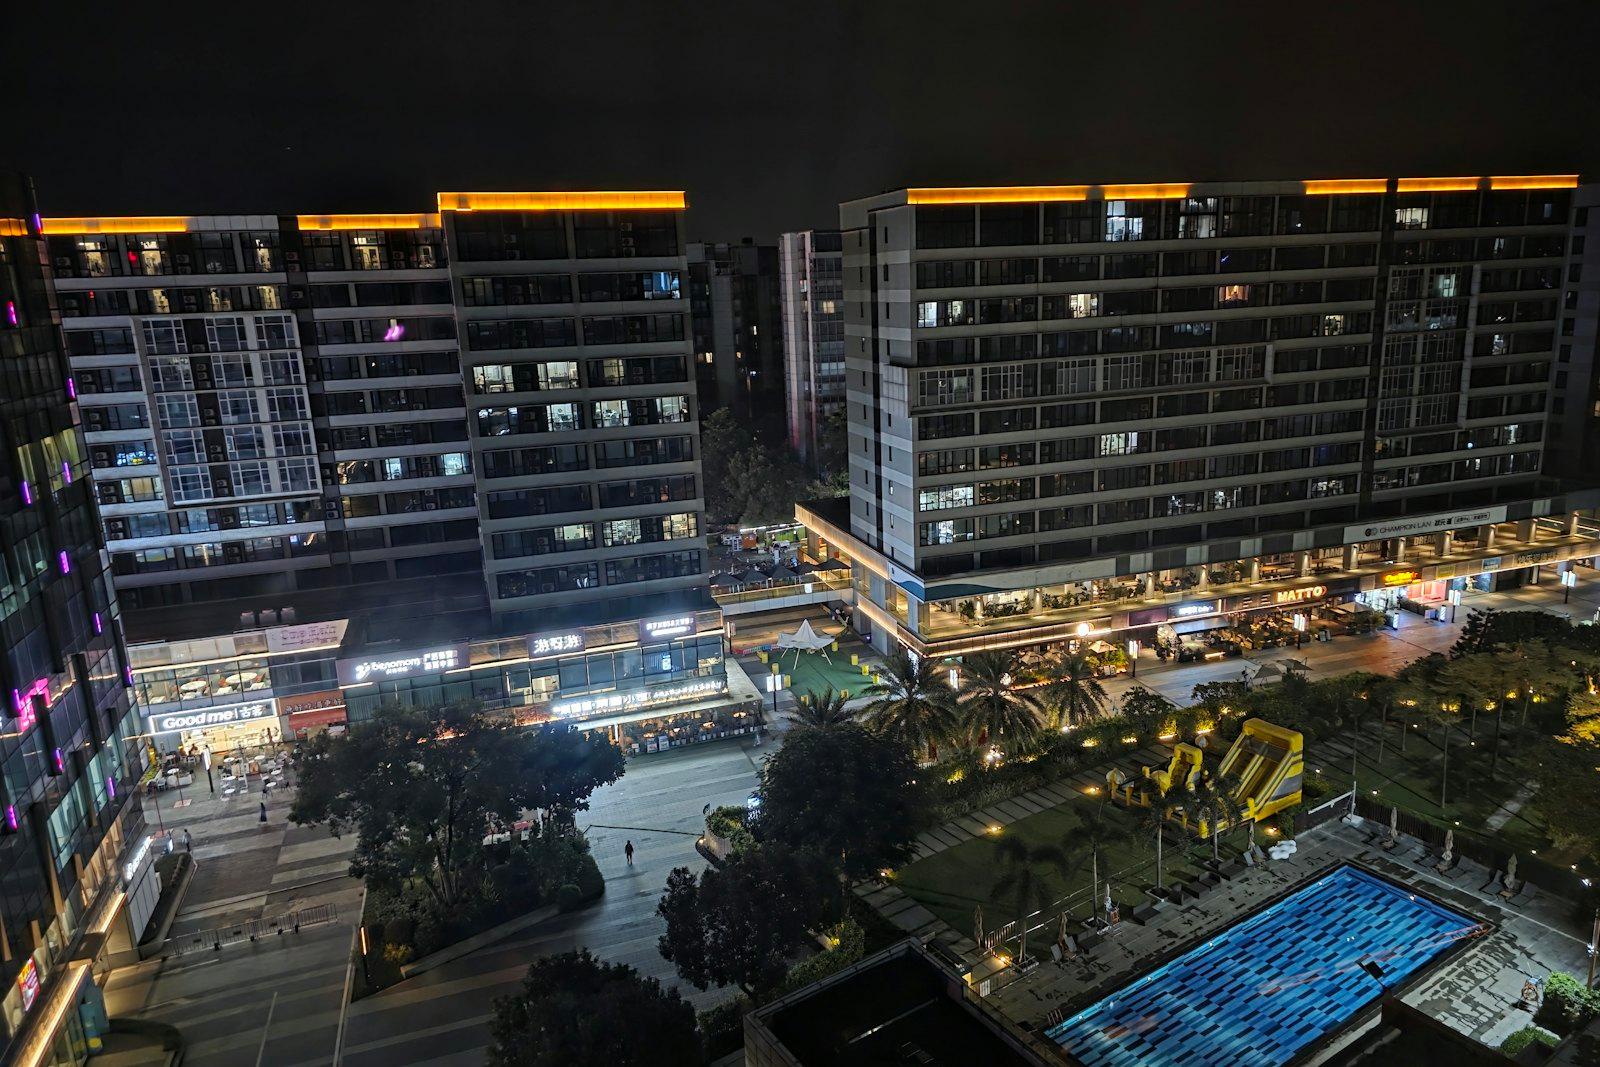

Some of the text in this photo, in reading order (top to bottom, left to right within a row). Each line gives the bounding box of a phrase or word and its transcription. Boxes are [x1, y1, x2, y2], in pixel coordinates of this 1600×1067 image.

[1379, 521, 1416, 534] CHAMPION
[1417, 520, 1431, 529] LAN
[1277, 586, 1323, 603] MATTO
[239, 704, 264, 718] 古茗
[162, 709, 233, 729] Good me
